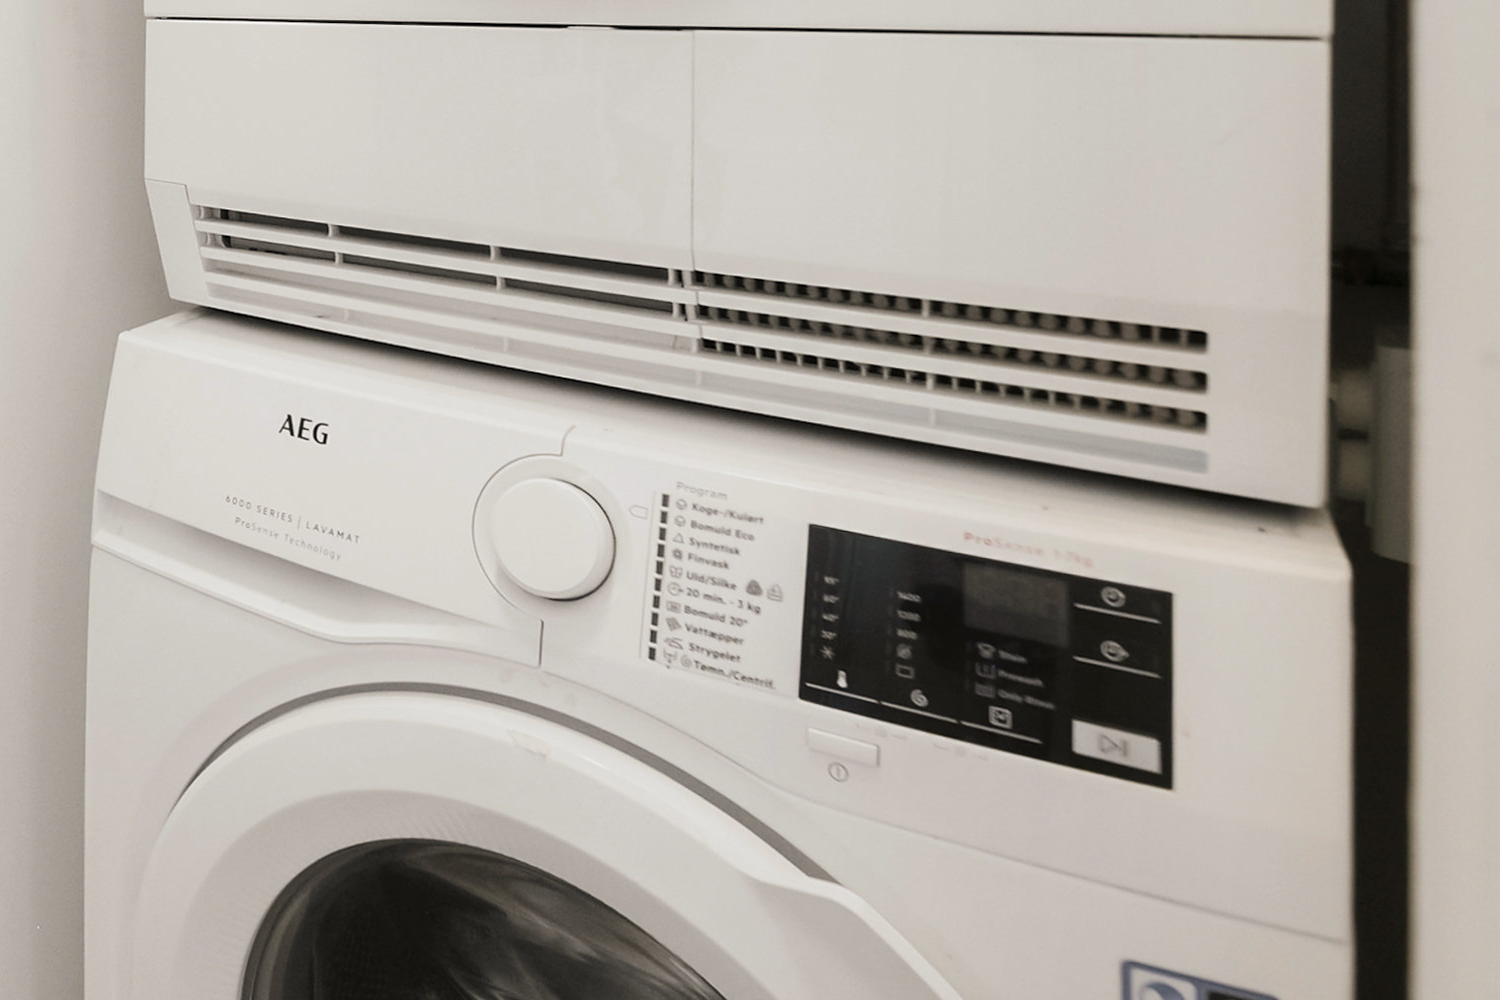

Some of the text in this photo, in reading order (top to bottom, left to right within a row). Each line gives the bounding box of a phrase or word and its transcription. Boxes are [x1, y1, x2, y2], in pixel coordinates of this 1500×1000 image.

[278, 414, 330, 445] AEG
[676, 481, 728, 500] Program
[225, 495, 360, 543] 6000 SERIES LAVAMAT
[235, 516, 342, 560] ProSense Technology
[690, 520, 755, 541] Bomuld Eco
[689, 536, 740, 556] Syntetisk
[687, 552, 729, 569] Finvask
[686, 571, 737, 591] Uld/Silke
[686, 588, 700, 598] 20
[747, 601, 761, 615] kg
[684, 605, 726, 623] Bomuld
